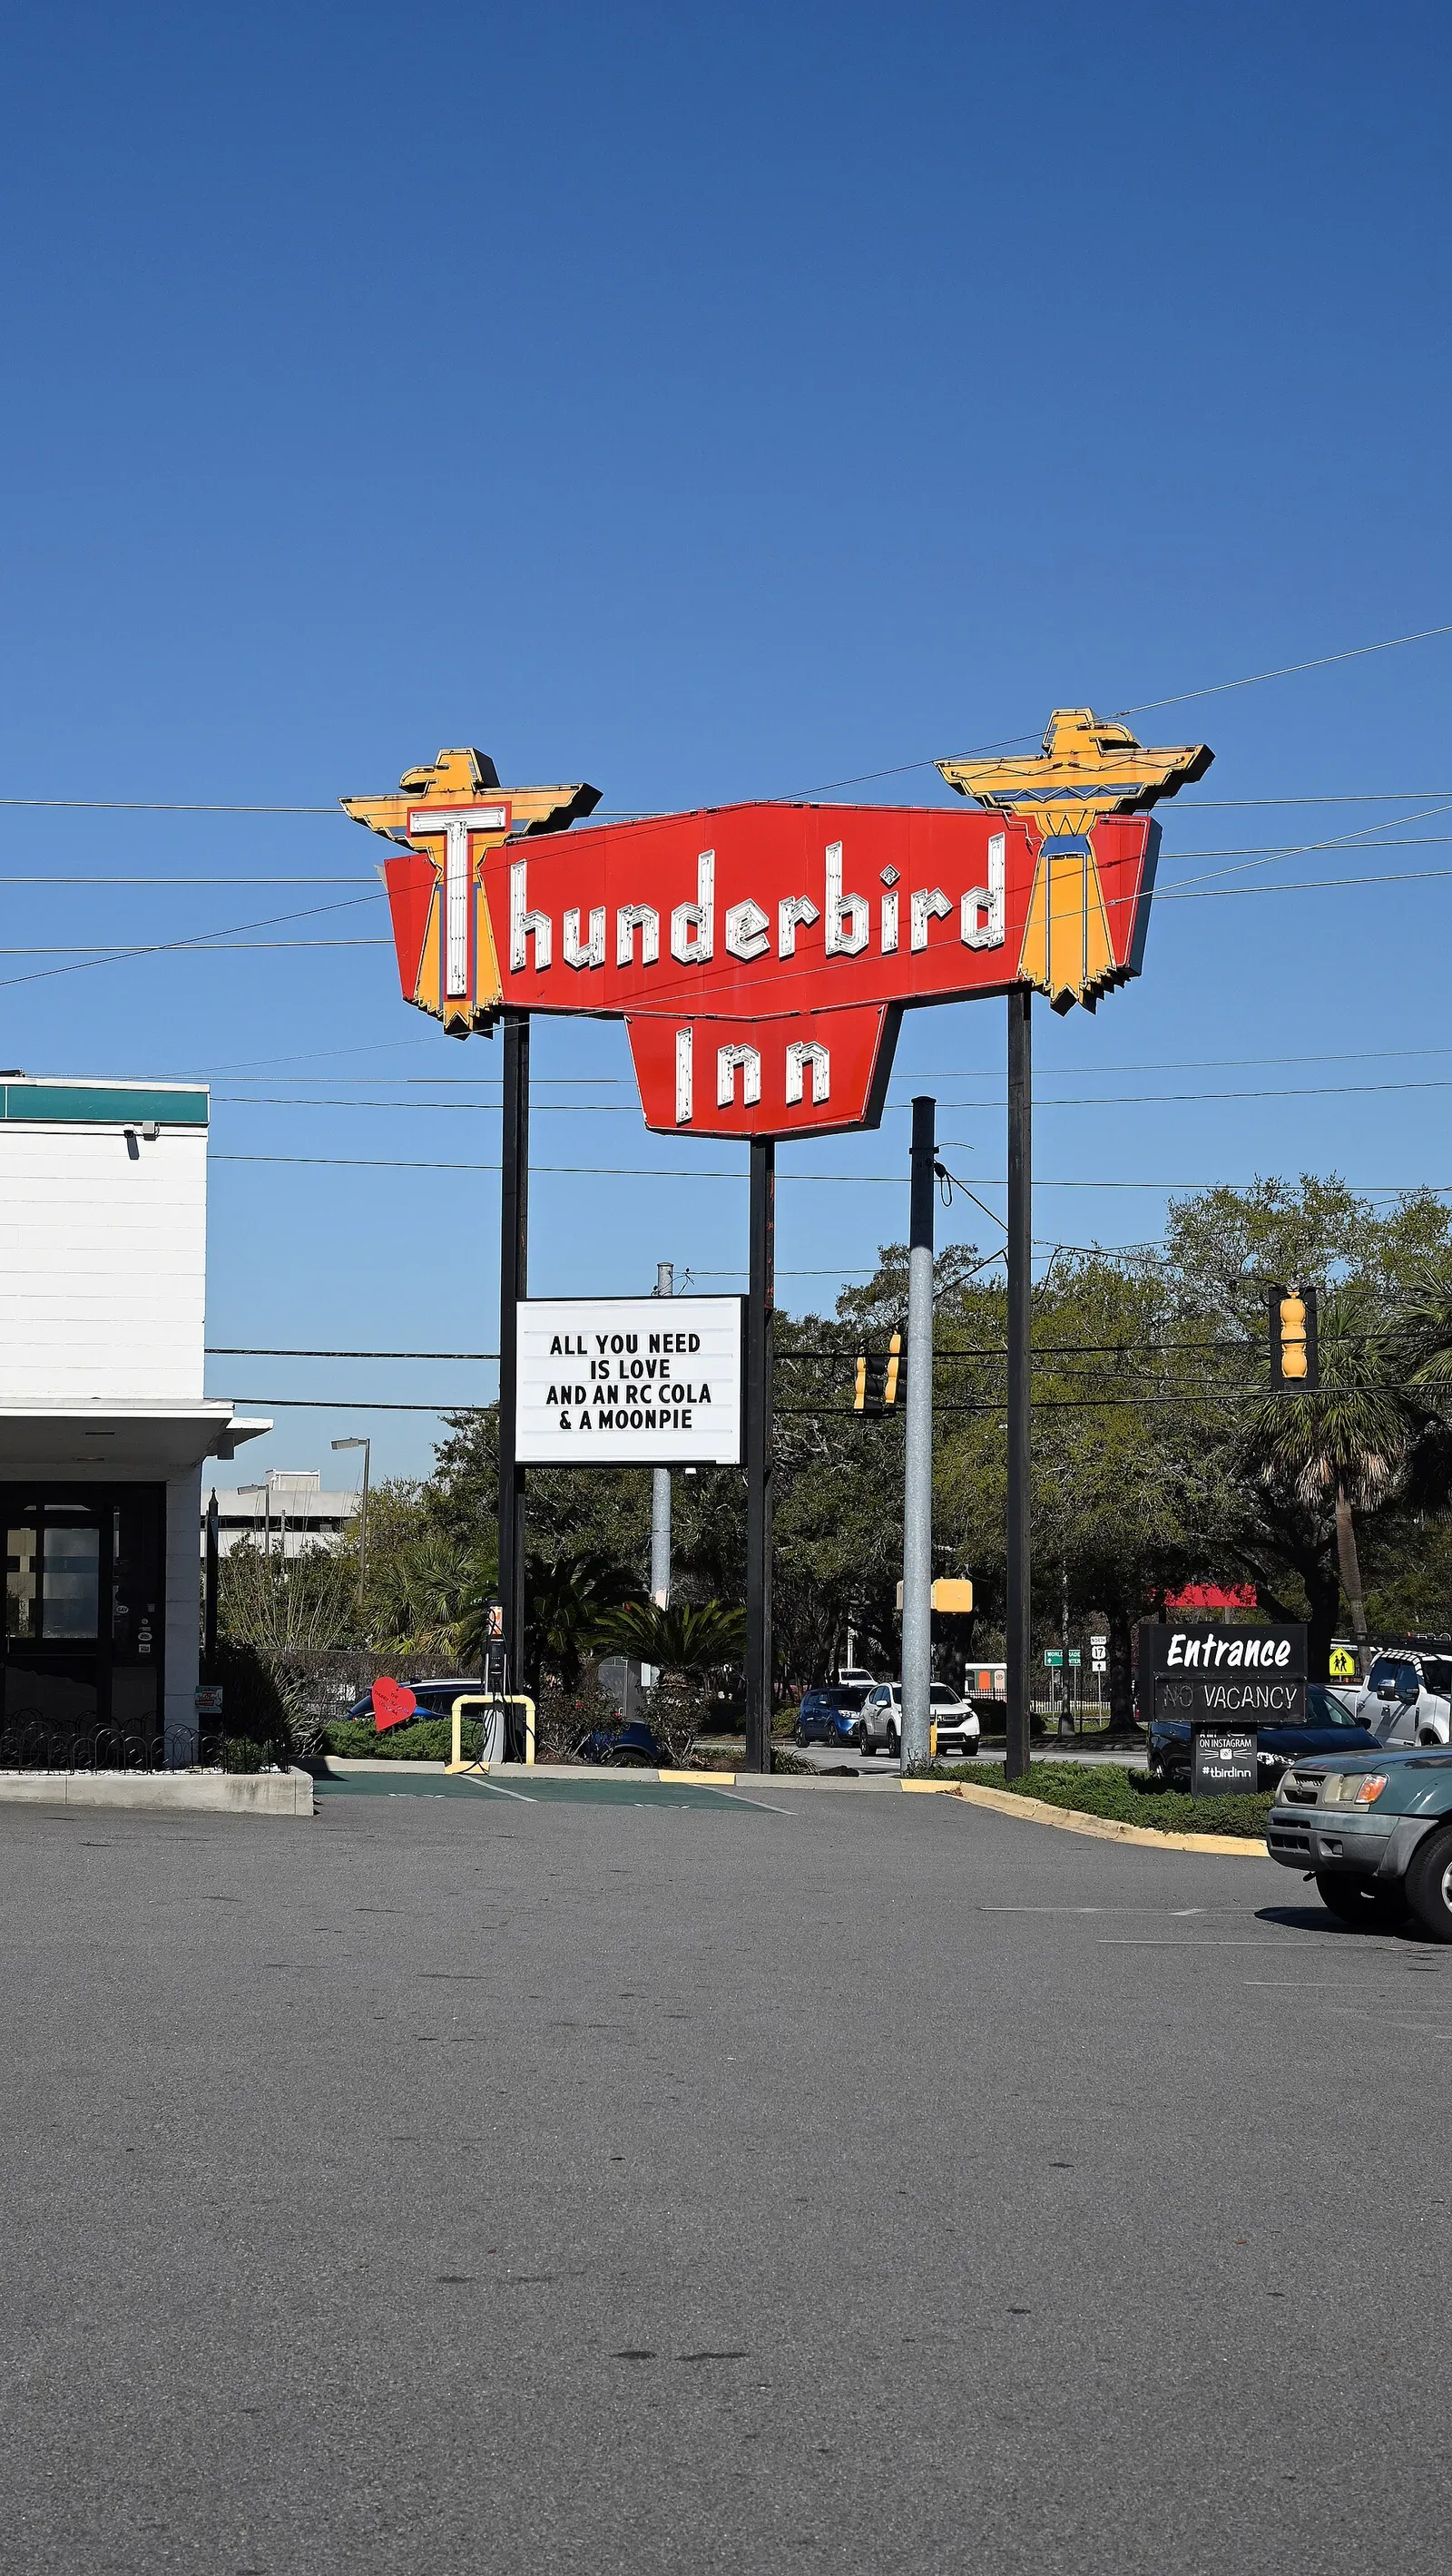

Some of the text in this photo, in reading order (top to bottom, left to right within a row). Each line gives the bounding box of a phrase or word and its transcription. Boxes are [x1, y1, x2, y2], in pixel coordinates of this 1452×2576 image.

[409, 806, 1006, 996] Thunderbird
[675, 1026, 830, 1124] Inn
[550, 1333, 701, 1355] ALL YOU NEED
[590, 1359, 671, 1379] IS LOVE
[545, 1384, 711, 1405] AND AN RC COLA
[559, 1409, 692, 1430] & A MOONPIE
[1094, 1648, 1104, 1657] 17
[1166, 1633, 1291, 1668] Entrance
[1163, 1684, 1298, 1710] NO VACANCY
[1199, 1739, 1252, 1748] ON INSTAGRAM
